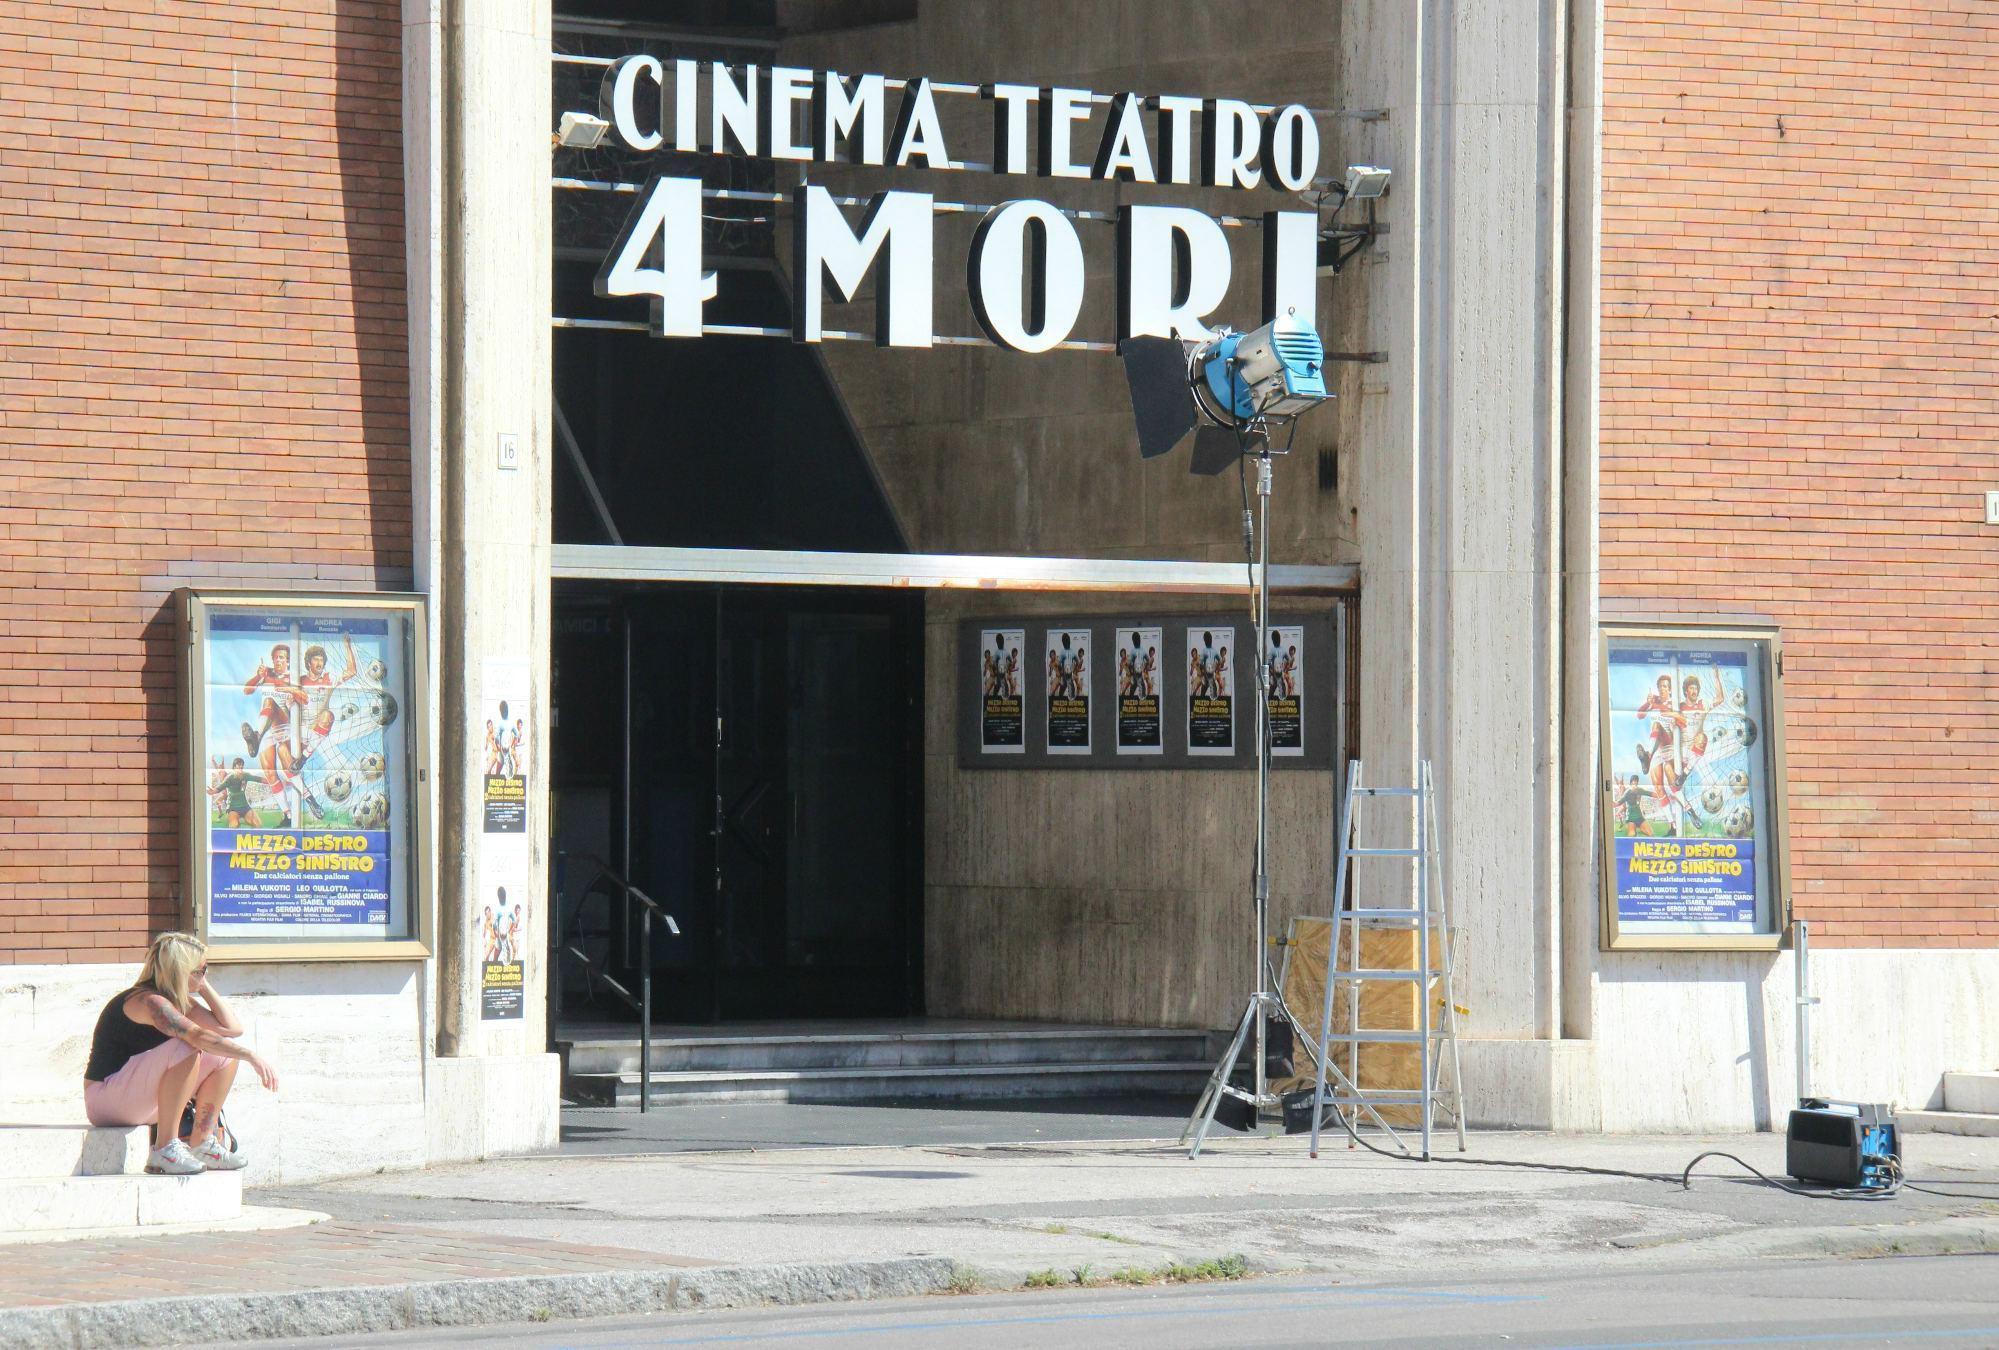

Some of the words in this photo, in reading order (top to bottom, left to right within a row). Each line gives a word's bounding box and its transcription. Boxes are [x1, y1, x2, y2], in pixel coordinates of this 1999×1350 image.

[611, 54, 951, 169] CINEMA
[993, 84, 1321, 192] TEATRO
[605, 177, 718, 338] 4
[804, 185, 1319, 354] MORI
[504, 441, 515, 460] 16
[314, 618, 343, 626] ANDREA
[236, 834, 297, 851] MEZZO
[302, 835, 368, 852] DESTRO
[1633, 841, 1681, 858] MEZZO
[1685, 842, 1738, 859] DESTRO
[229, 852, 292, 871] MEZZO
[296, 853, 375, 873] SINISTRO
[1629, 857, 1678, 875] MEZZO
[1680, 859, 1743, 876] SINISTRO
[254, 872, 268, 880] Due
[269, 872, 301, 880] calciatori
[324, 873, 350, 881] pallone
[326, 899, 366, 907] RUSSINOVA
